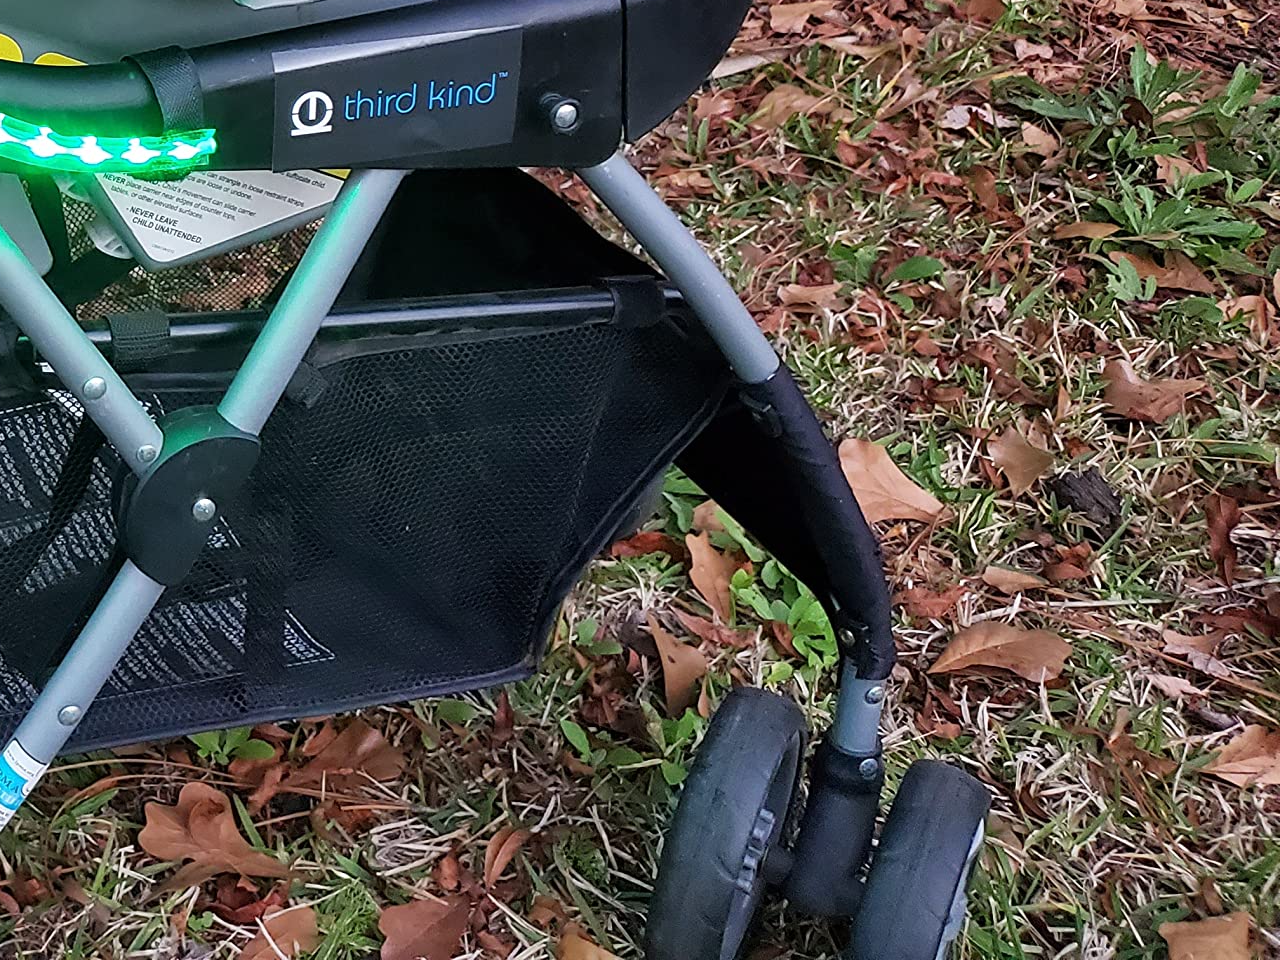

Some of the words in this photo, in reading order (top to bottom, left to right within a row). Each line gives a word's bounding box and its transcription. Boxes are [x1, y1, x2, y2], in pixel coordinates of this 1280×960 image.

[345, 83, 417, 120] third
[428, 73, 496, 110] kind
[103, 171, 126, 184] NEVER
[129, 206, 154, 219] NEVER
[155, 214, 178, 227] LEAVE
[132, 216, 154, 228] CHILD
[155, 224, 202, 243] UNATTENDED.
